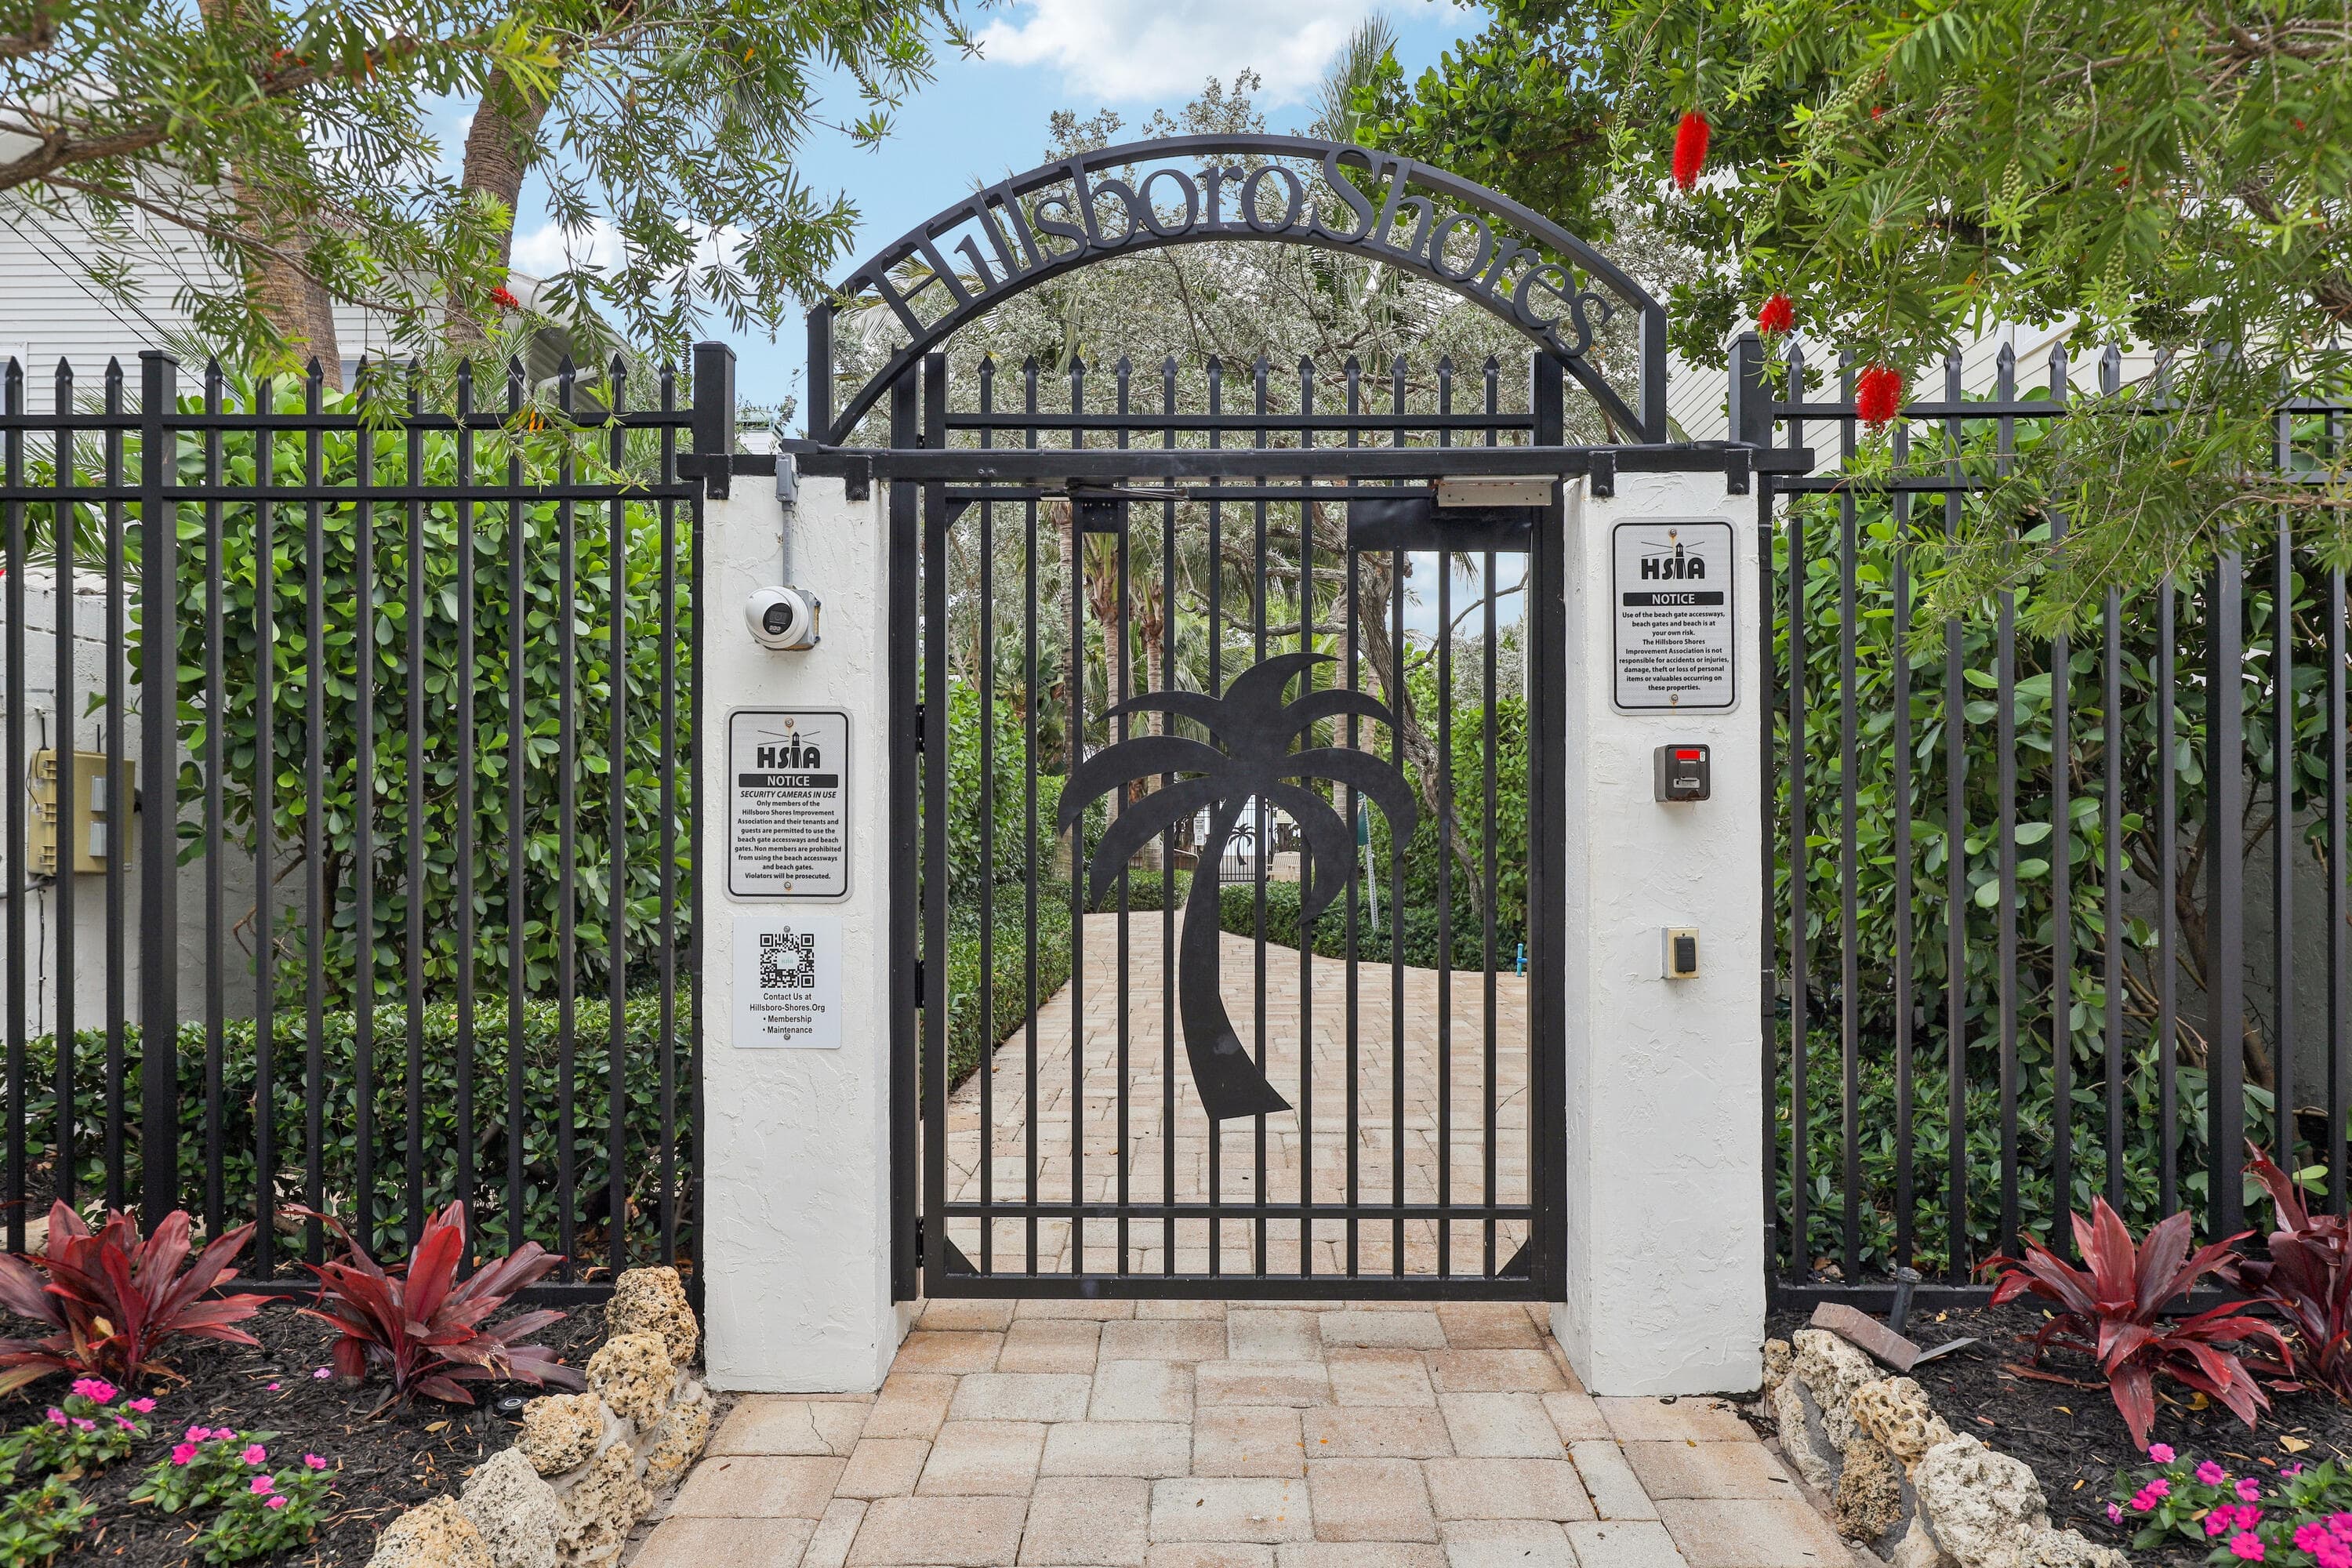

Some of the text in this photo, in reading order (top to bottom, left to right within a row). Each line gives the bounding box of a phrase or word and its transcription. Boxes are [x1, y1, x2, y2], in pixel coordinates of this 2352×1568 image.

[854, 143, 1616, 358] Hillsboro Shores
[1641, 557, 1705, 580] HSIA
[1651, 593, 1696, 605] NOTICE
[1626, 648, 1668, 656] Improvement
[1619, 656, 1655, 666] responsible
[1704, 655, 1729, 665] injuries,
[1624, 666, 1650, 674] damage,
[1697, 665, 1724, 673] personal
[1683, 674, 1712, 683] occurring
[1667, 684, 1700, 692] properties.
[757, 746, 821, 769] HSIA
[767, 775, 811, 787] NOTICE
[777, 790, 811, 799] CAMERAS
[813, 790, 821, 799] IN
[822, 790, 837, 799] USE
[757, 800, 771, 808] Only
[793, 809, 834, 818] Improvement
[774, 826, 804, 835] permitted
[809, 845, 841, 854] prohibited
[754, 854, 771, 862] using
[764, 992, 791, 1000] Contact
[750, 1003, 825, 1013] Hillsboro-Shores.Org
[768, 1014, 811, 1025] Membership
[768, 1025, 812, 1034] Maintenance
